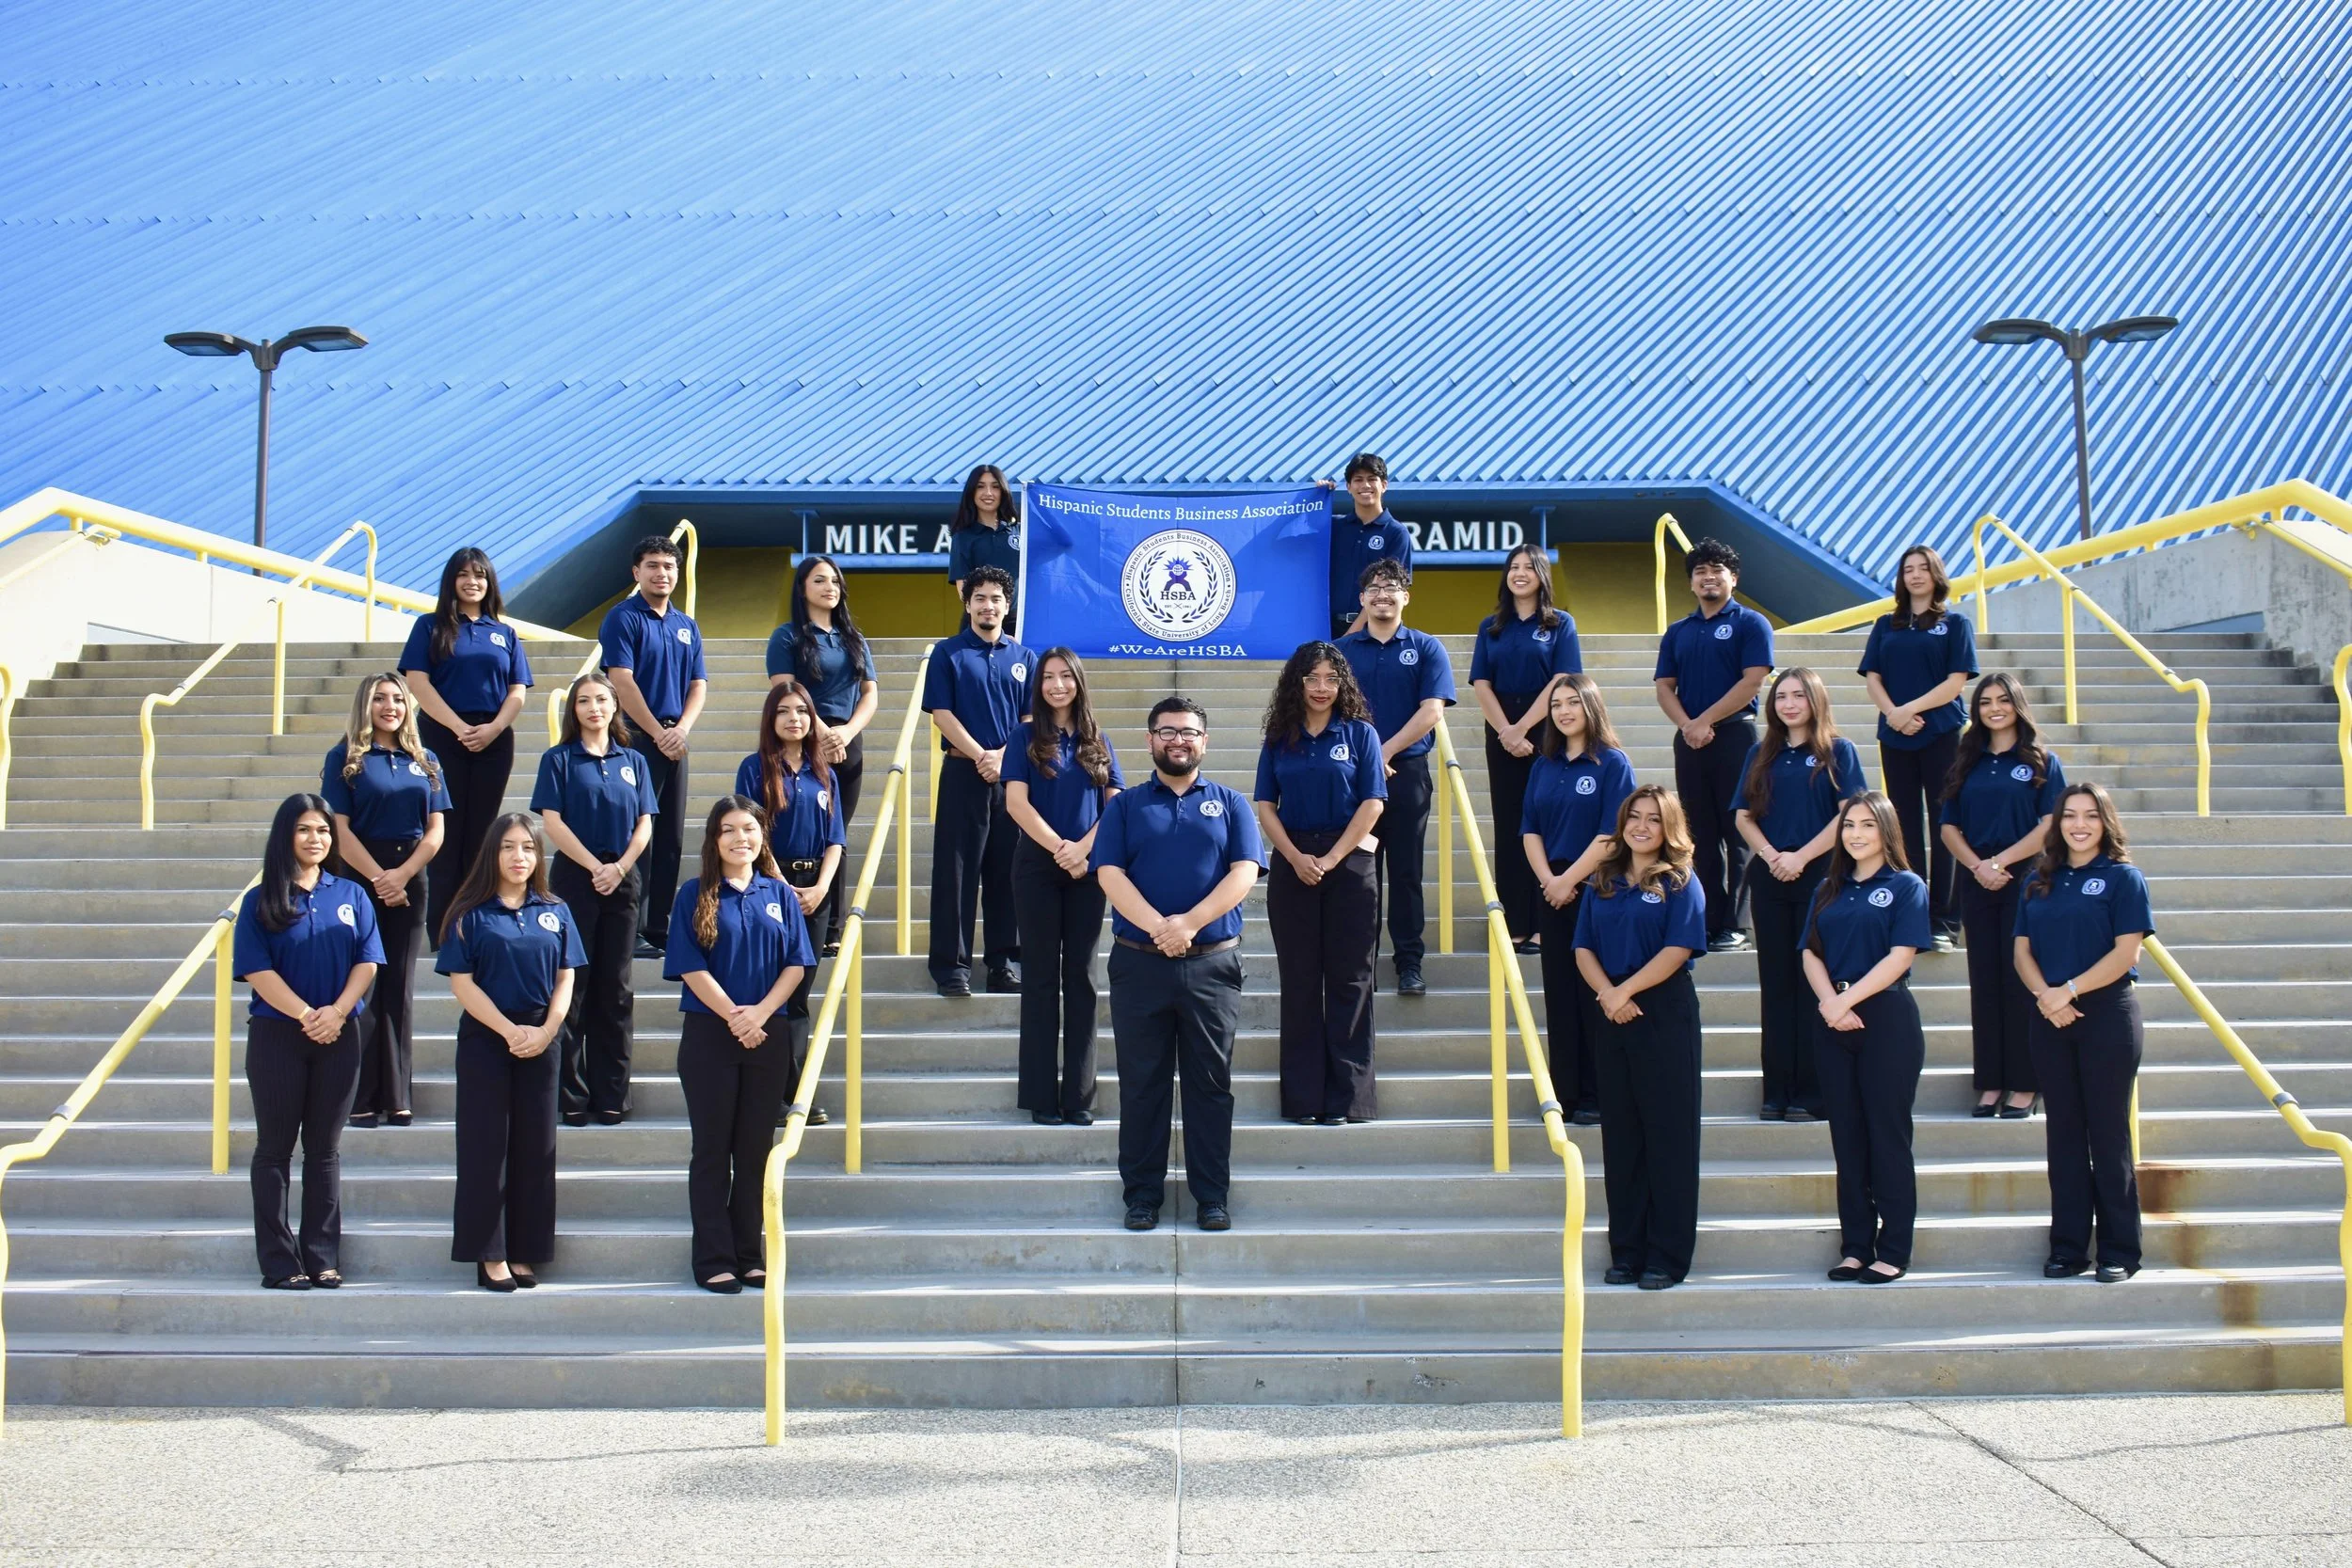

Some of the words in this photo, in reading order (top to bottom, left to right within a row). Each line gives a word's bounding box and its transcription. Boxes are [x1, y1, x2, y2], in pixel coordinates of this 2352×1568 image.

[1039, 494, 1103, 515] Hispanic
[1106, 503, 1171, 520] Students
[1175, 507, 1238, 521] Business
[1241, 499, 1324, 518] Association
[825, 524, 918, 554] MIKE
[1402, 521, 1523, 551] RAMID
[1126, 551, 1142, 580] Hispanic
[1143, 535, 1174, 552] Students
[1176, 533, 1207, 546] Business
[1208, 545, 1231, 582] Association
[1160, 592, 1196, 600] HSBA
[1126, 588, 1142, 622] California
[1142, 621, 1159, 634] State
[1162, 630, 1199, 638] University
[1201, 623, 1208, 632] of
[1208, 612, 1224, 626] Long
[1220, 589, 1231, 610] Beach
[1108, 644, 1247, 657] #WeAreHSBA
